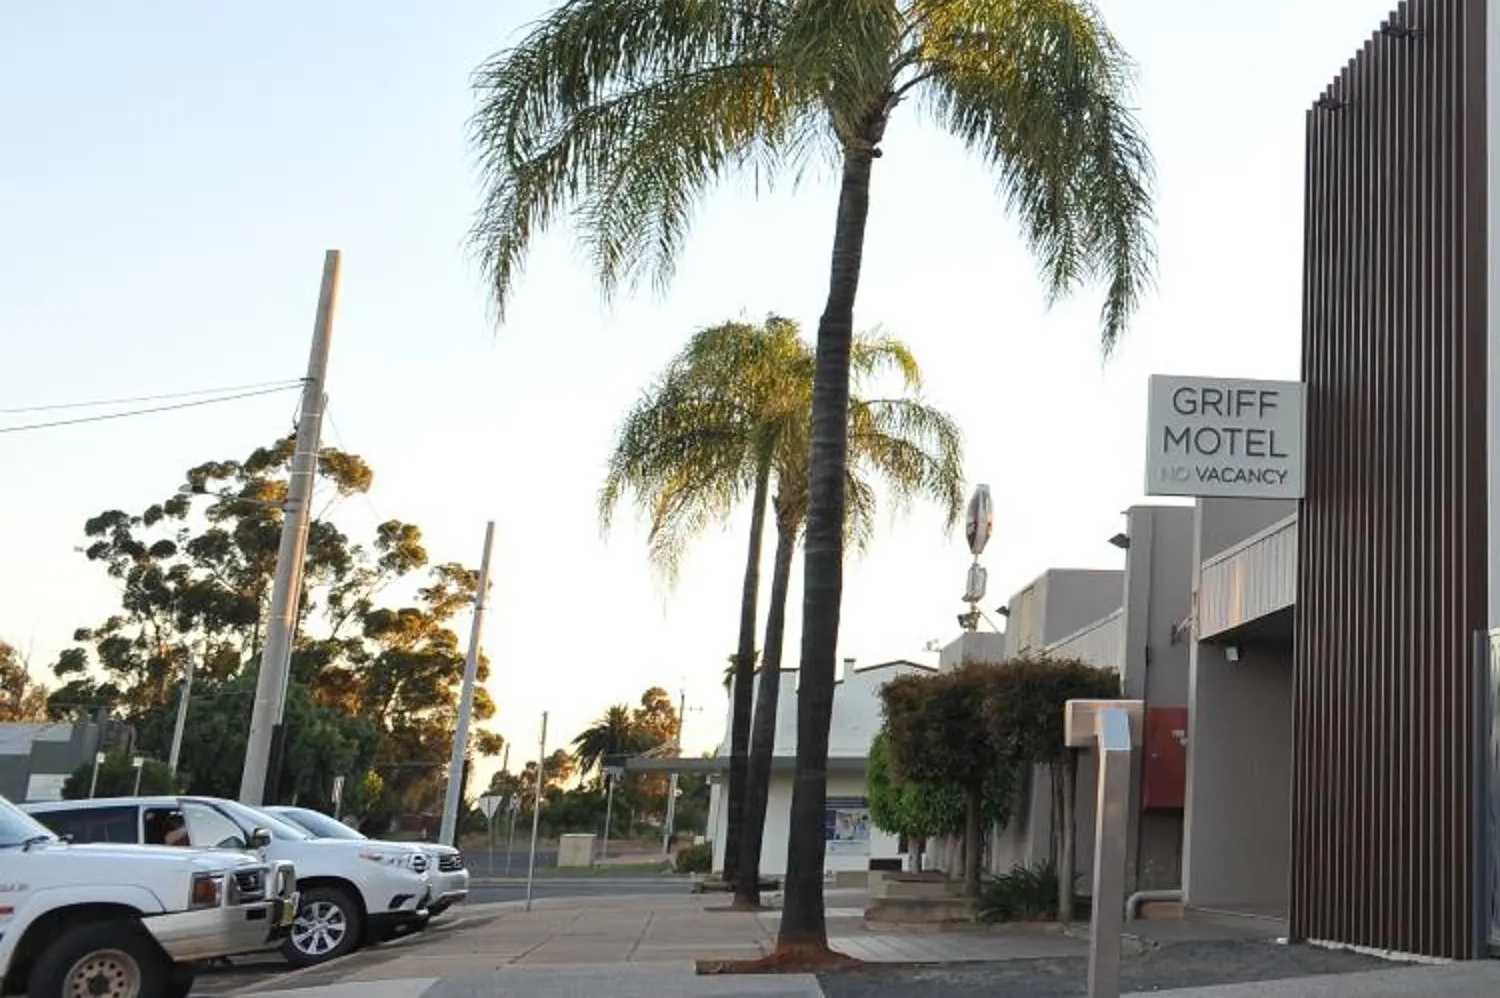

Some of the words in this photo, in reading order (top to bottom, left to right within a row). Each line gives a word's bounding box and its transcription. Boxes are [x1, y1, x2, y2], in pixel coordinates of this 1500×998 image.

[1172, 386, 1279, 418] GRIFF
[1163, 425, 1289, 458] MOTEL
[1160, 466, 1191, 483] NO
[1195, 466, 1288, 484] VACANCY
